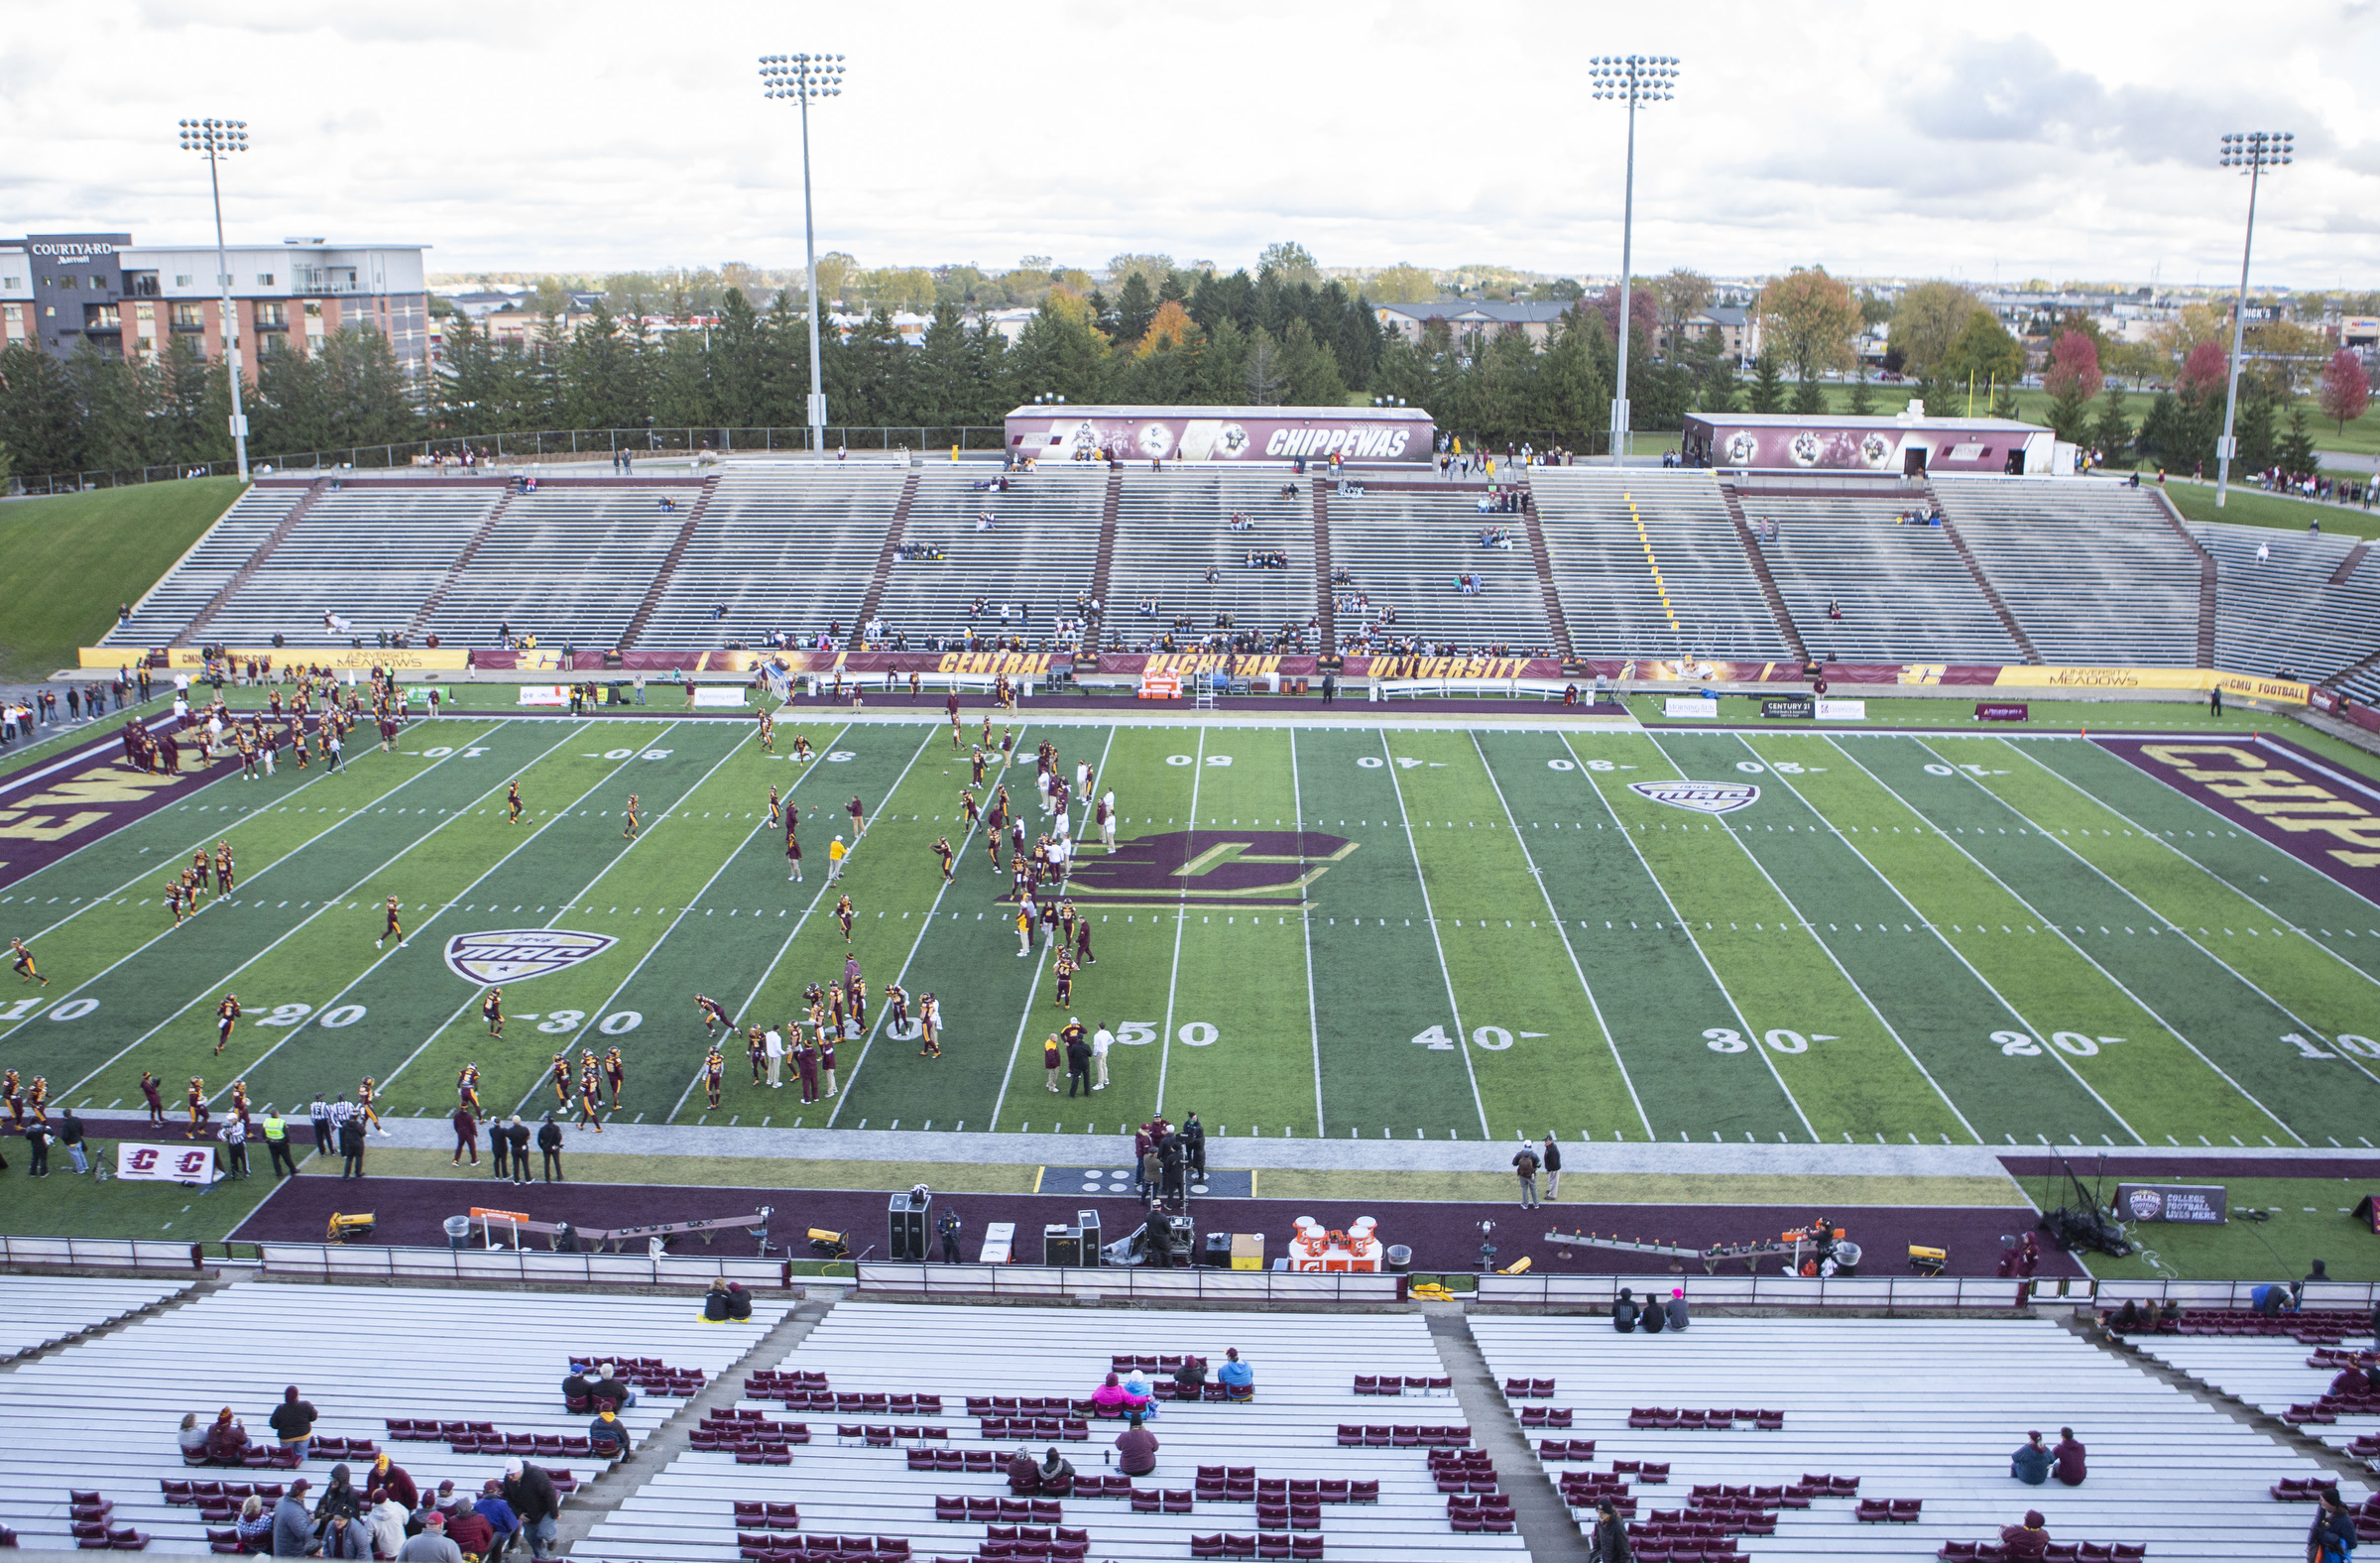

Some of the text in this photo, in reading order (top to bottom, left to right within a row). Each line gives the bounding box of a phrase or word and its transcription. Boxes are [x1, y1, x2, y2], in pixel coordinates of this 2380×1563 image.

[32, 243, 112, 255] COURTYARD
[1265, 428, 1410, 457] CHIPPEWAS
[337, 656, 422, 667] MEADOWS
[937, 653, 1531, 678] CENTRAL MICHIGAN UNIVERSITY
[2049, 672, 2138, 685] MEADOWS
[2258, 683, 2305, 699] FOOTBALL
[2139, 745, 2380, 868] CHIP
[1059, 965, 1070, 975] 44
[1116, 1022, 1220, 1046] 50
[1411, 1024, 1514, 1051] 40
[1702, 1027, 1809, 1054] 30
[1989, 1030, 2099, 1057] 20
[2167, 1194, 2204, 1203] COLLEGE
[2165, 1210, 2216, 1220] LIVES HERE
